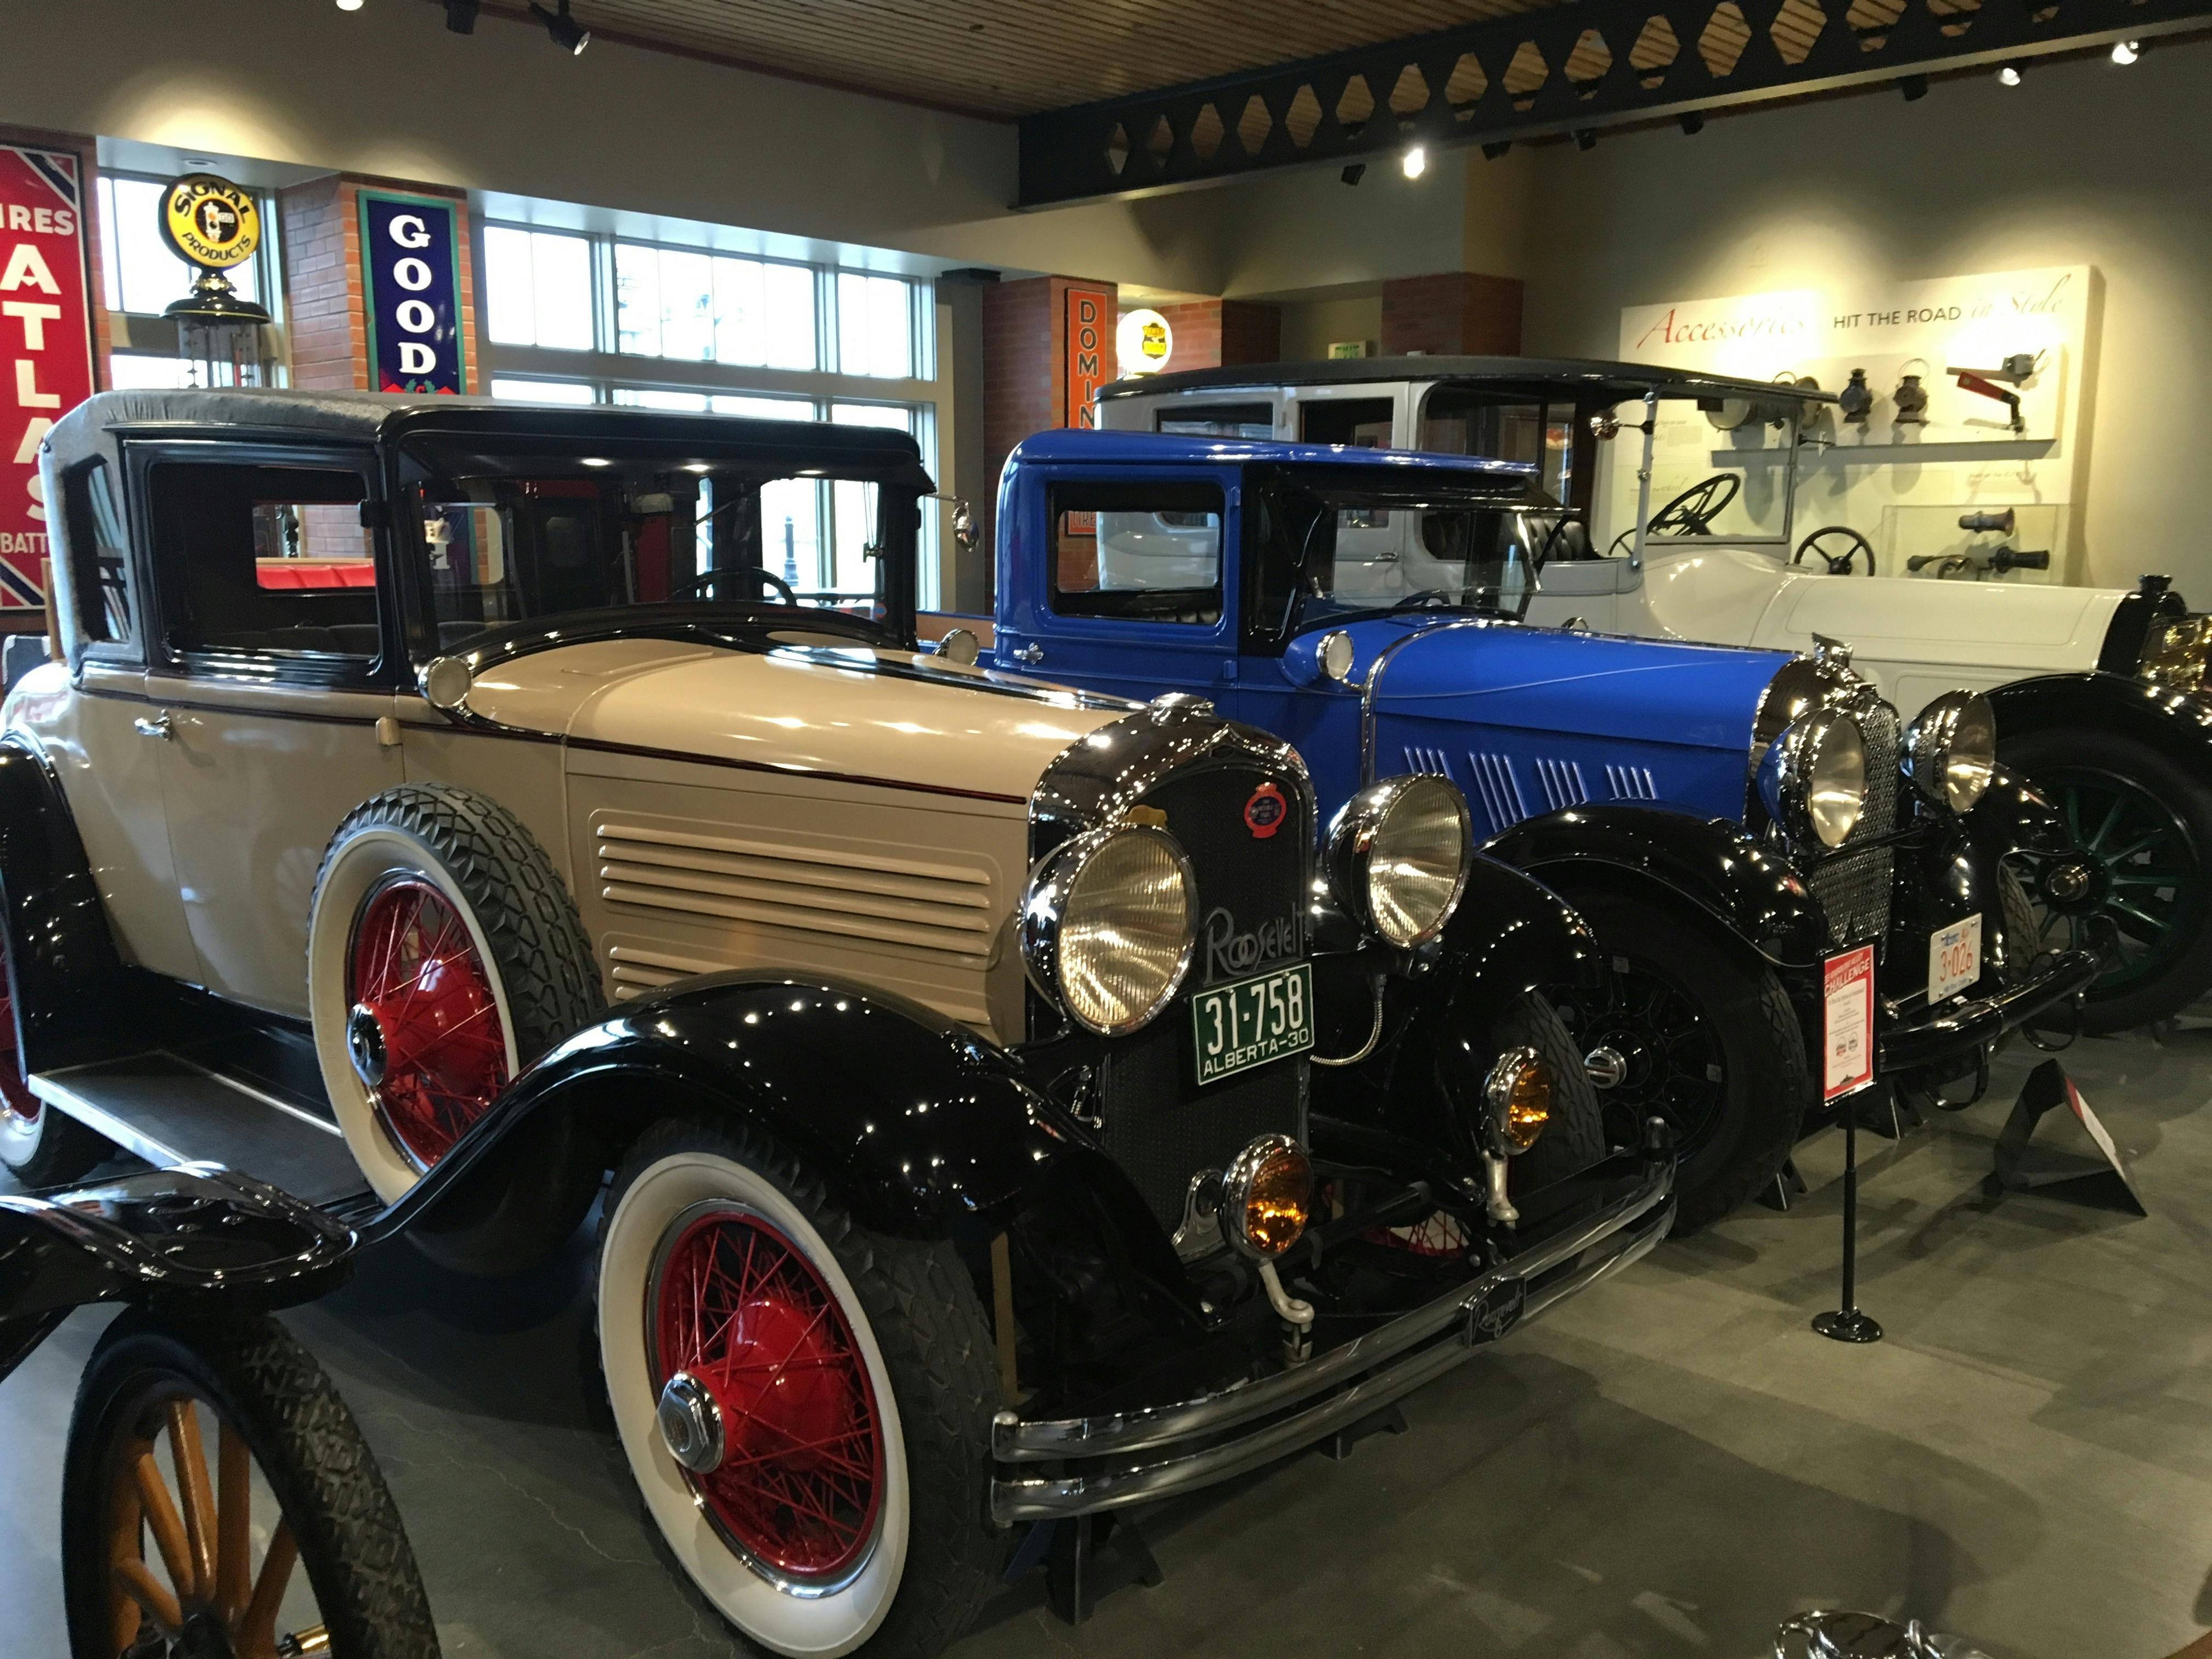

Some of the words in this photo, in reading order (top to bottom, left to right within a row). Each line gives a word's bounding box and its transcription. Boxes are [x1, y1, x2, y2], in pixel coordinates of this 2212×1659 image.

[174, 182, 250, 224] SIGNAL
[182, 232, 251, 261] PRODUCTS
[388, 215, 437, 374] GOOD
[1833, 314, 1863, 329] HIT
[1867, 311, 1901, 327] THE
[1906, 307, 1962, 325] ROAD
[1203, 902, 1305, 988] Roosevelt
[1825, 957, 1870, 998] CHALLENGE
